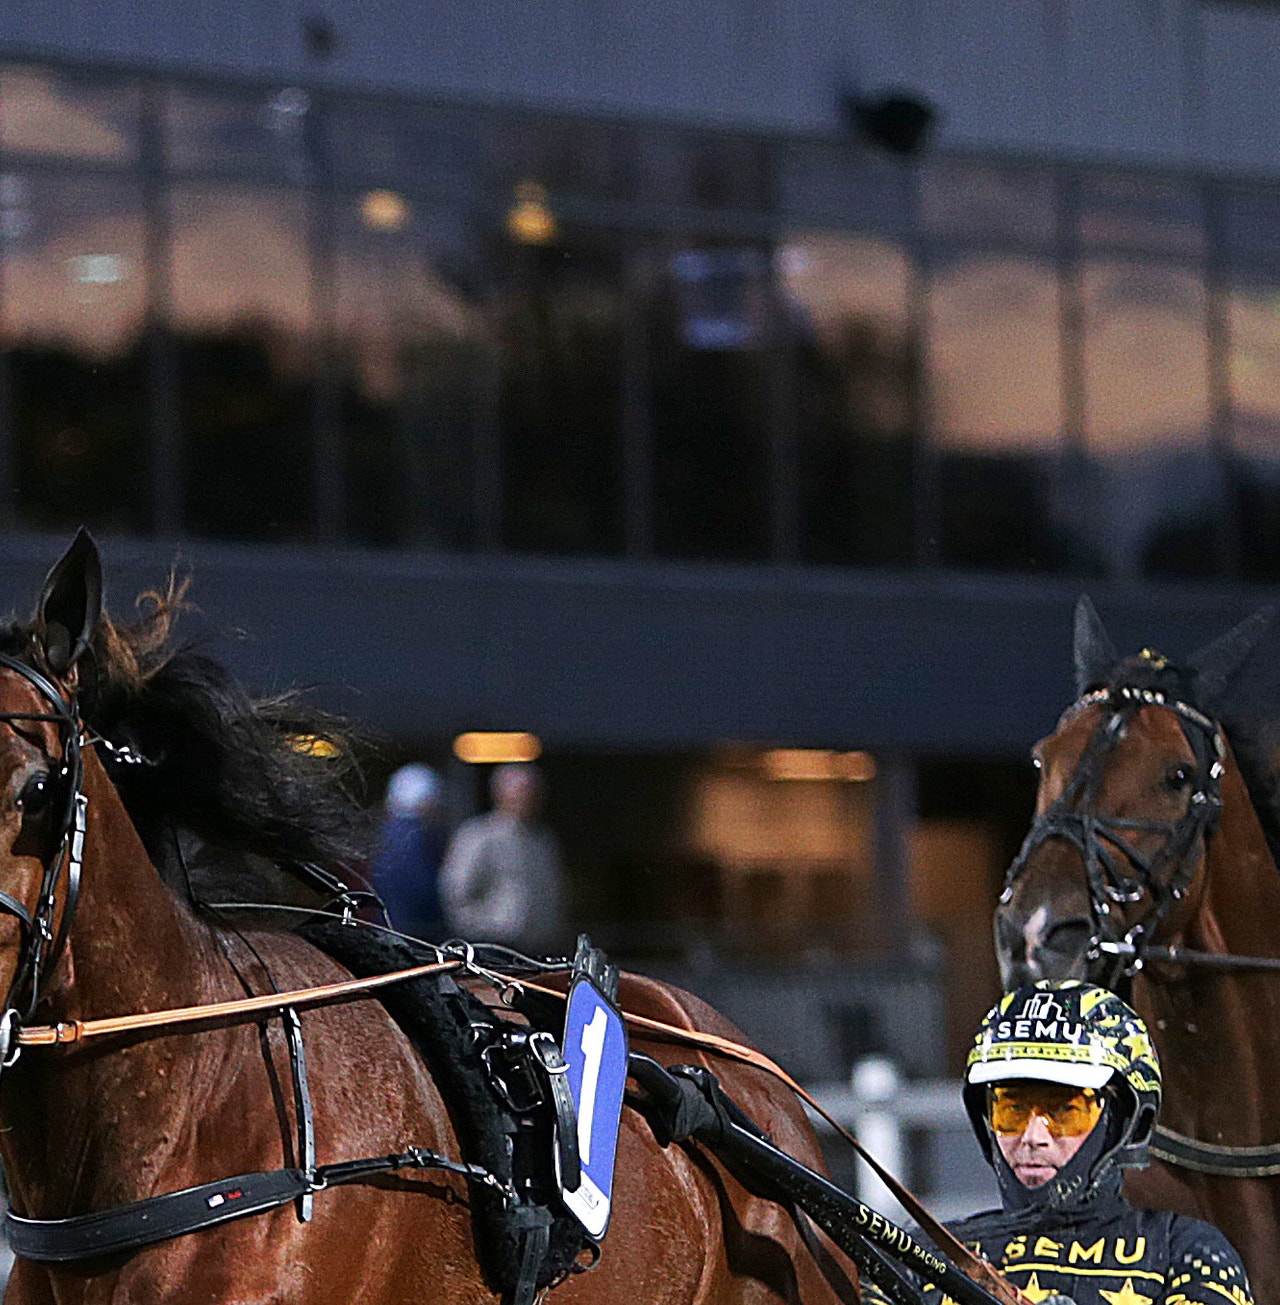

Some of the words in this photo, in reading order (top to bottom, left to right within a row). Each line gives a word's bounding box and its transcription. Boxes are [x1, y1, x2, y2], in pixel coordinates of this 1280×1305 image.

[997, 1019, 1084, 1046] SEMU
[577, 1005, 608, 1167] 1
[855, 1204, 913, 1253] SEMU
[911, 1244, 948, 1275] RACING
[1003, 1234, 1147, 1265] SEMU
